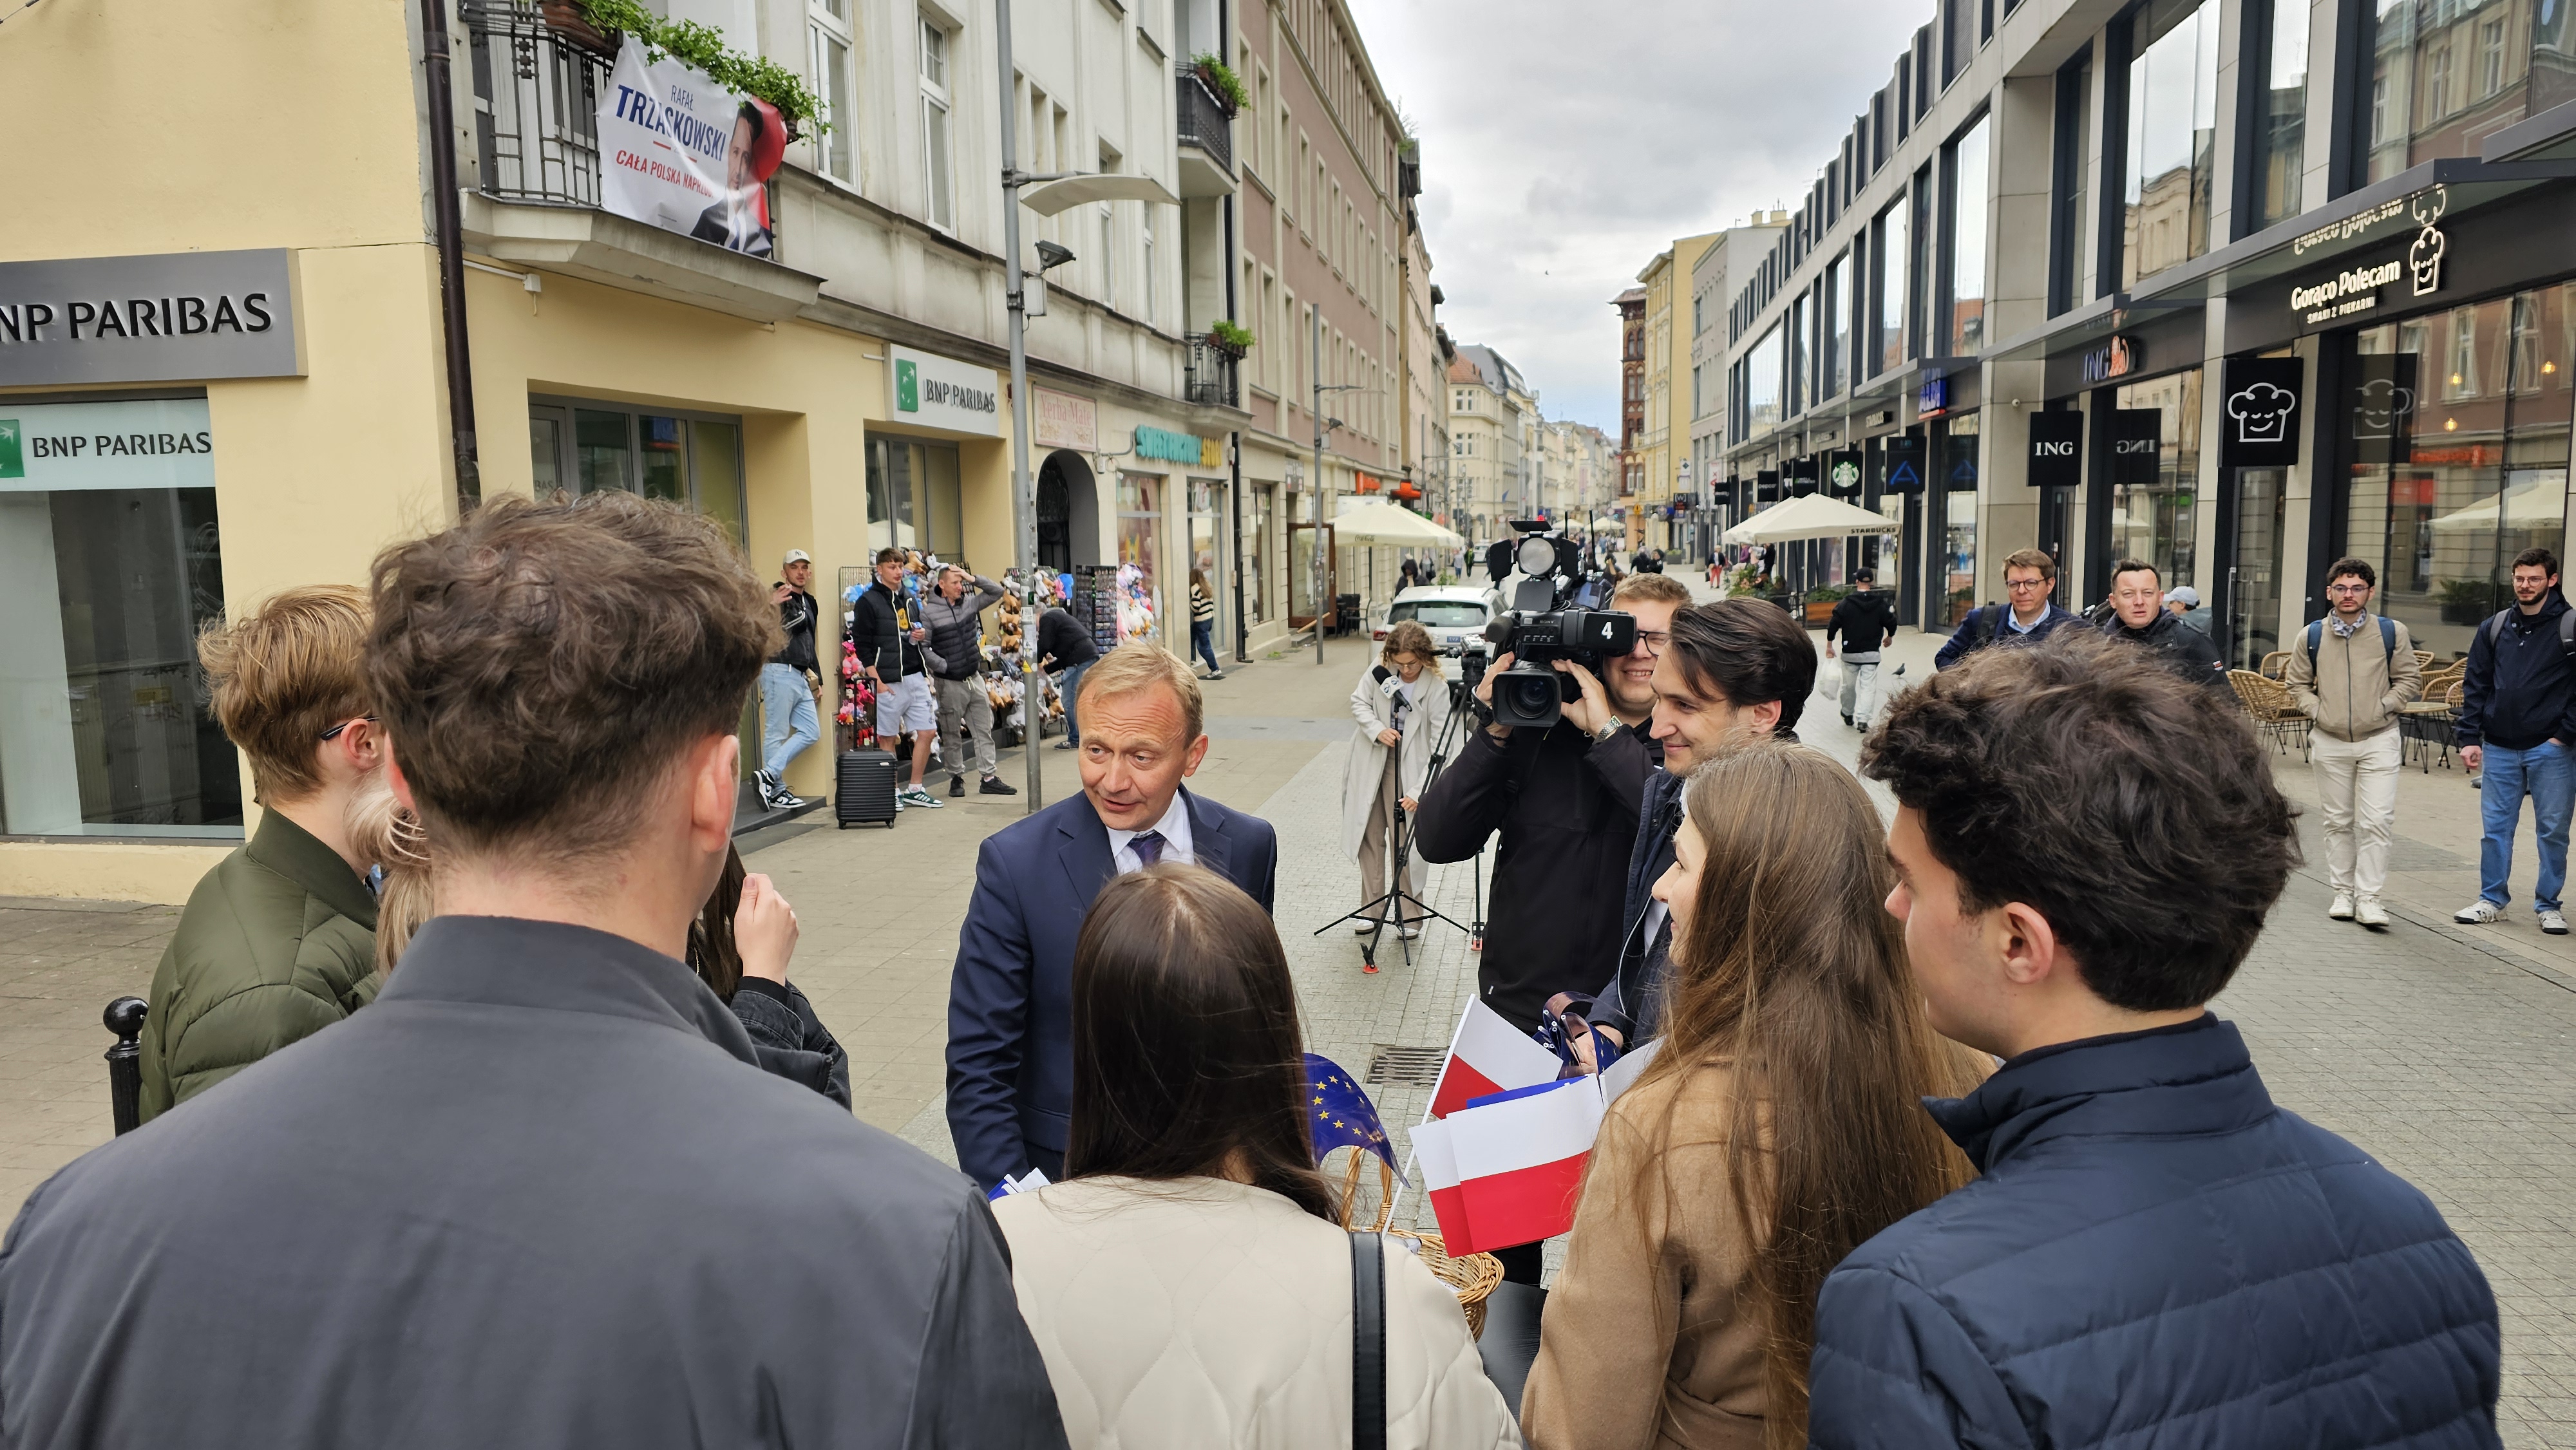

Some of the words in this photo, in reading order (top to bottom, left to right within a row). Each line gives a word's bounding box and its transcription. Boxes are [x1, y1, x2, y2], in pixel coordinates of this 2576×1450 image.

[670, 84, 694, 111] RAFAŁ
[616, 84, 726, 162] TRZASKOWSKI
[616, 149, 647, 173] CAŁA
[650, 160, 681, 186] POLSKA
[2291, 281, 2338, 310] Gorąco
[2338, 260, 2401, 297] Polecam
[68, 293, 272, 339] PARIBAS
[2307, 308, 2331, 325] SMAKI
[2331, 306, 2337, 318] Z
[2339, 296, 2376, 315] PIEKARNI
[2083, 346, 2109, 384] ING
[925, 378, 949, 404] BNP
[952, 384, 996, 413] PARIBAS
[1041, 394, 1067, 422] Yerba
[1070, 400, 1092, 426] Mate
[32, 436, 88, 458] BNP
[95, 431, 213, 457] PARIBAS
[2035, 440, 2074, 456] ING
[1601, 621, 1613, 640] 4
